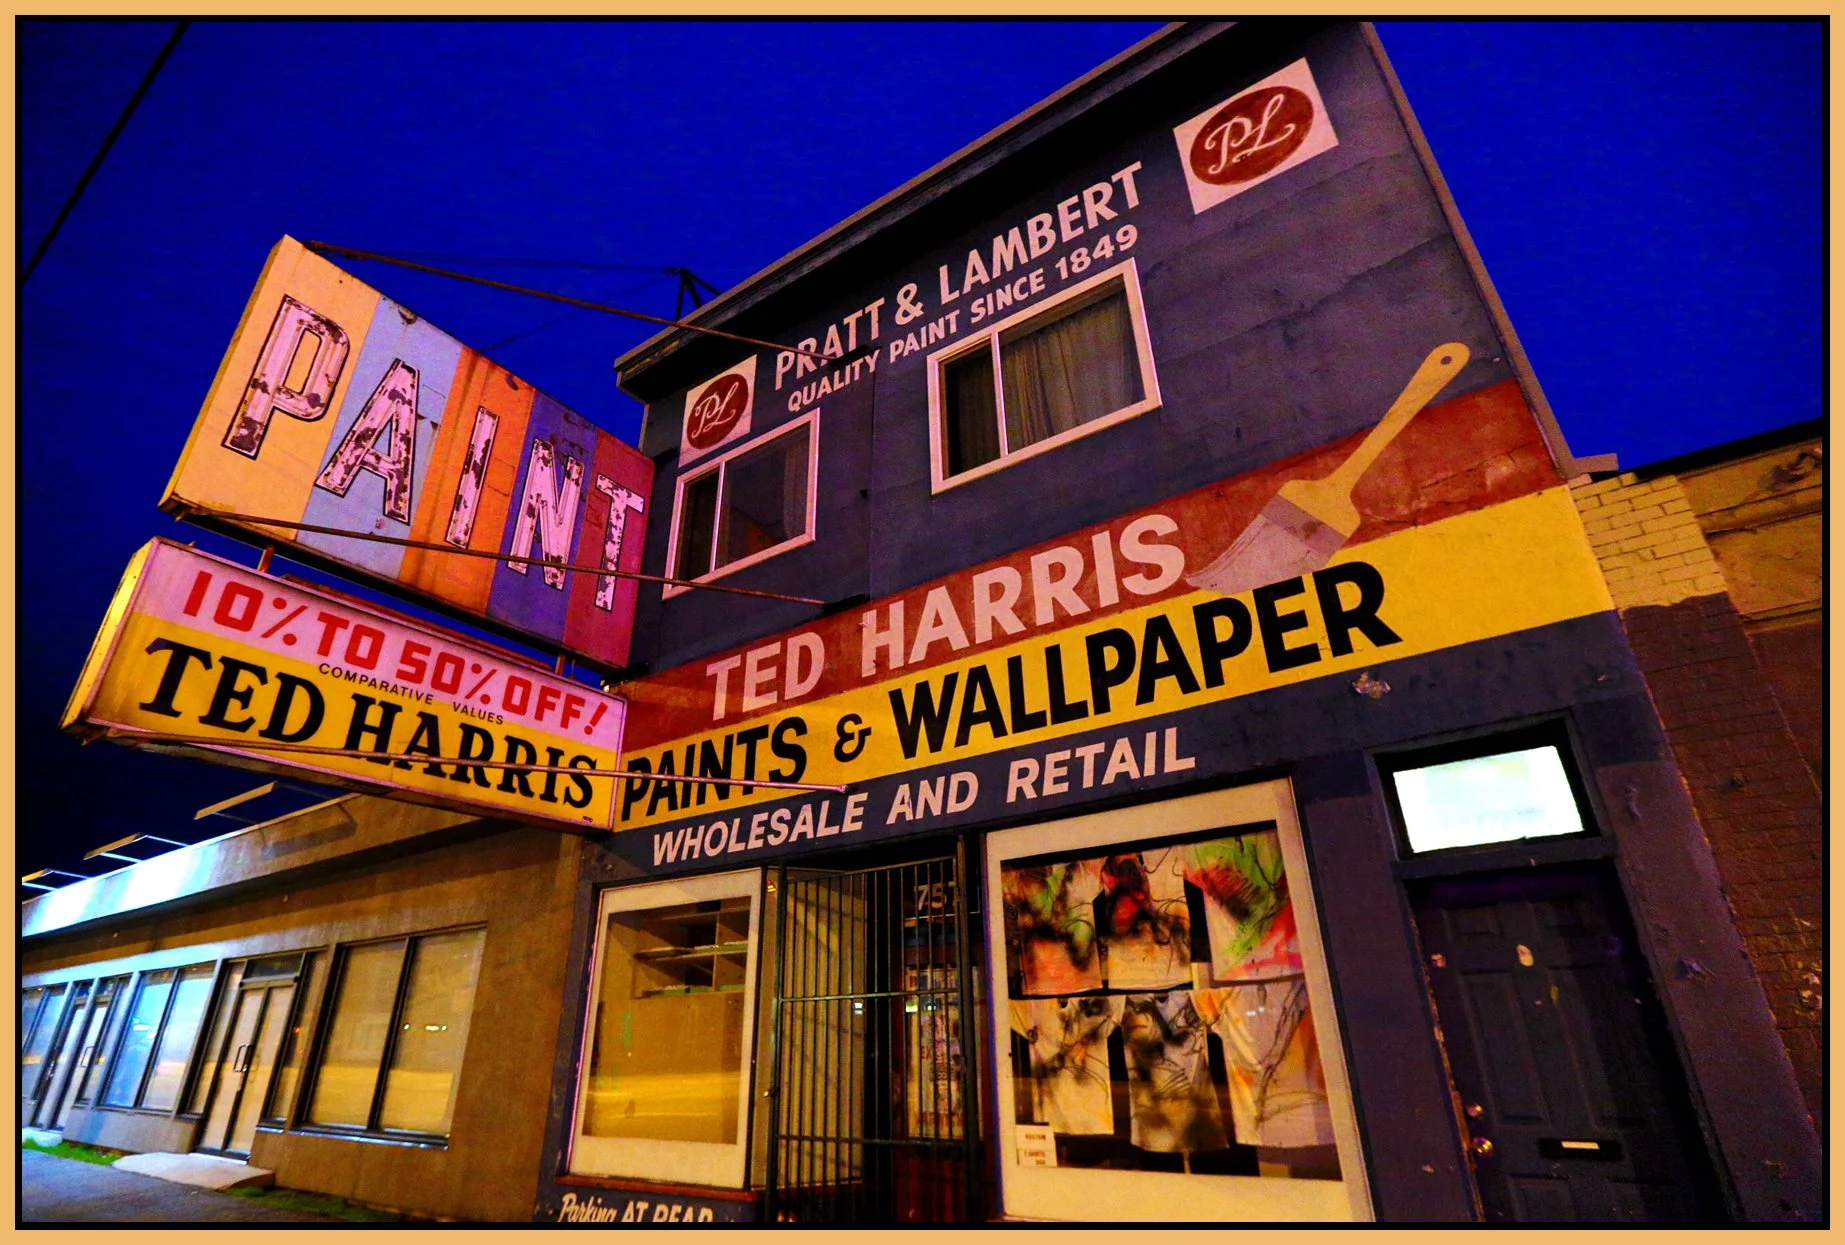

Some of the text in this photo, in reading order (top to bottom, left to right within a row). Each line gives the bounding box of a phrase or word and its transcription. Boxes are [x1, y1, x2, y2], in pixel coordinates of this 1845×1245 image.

[1204, 93, 1296, 175] PL
[775, 161, 1142, 391] PRATT & LAMBERT
[788, 224, 1138, 412] QUALITY PAINT SINCE 1849
[222, 294, 644, 611] PAINT
[691, 382, 739, 439] PL
[183, 571, 609, 735] 10% TO 50% OFF!
[318, 663, 504, 725] COMPARATIVE VALUES
[622, 561, 1402, 821] PAINTS & WALLPAPER
[704, 513, 1185, 720] TED HARRIS
[139, 637, 597, 808] TED HARRIS
[652, 727, 1196, 866] WHOLESALE AND RETAIL
[621, 1200, 649, 1222] AT
